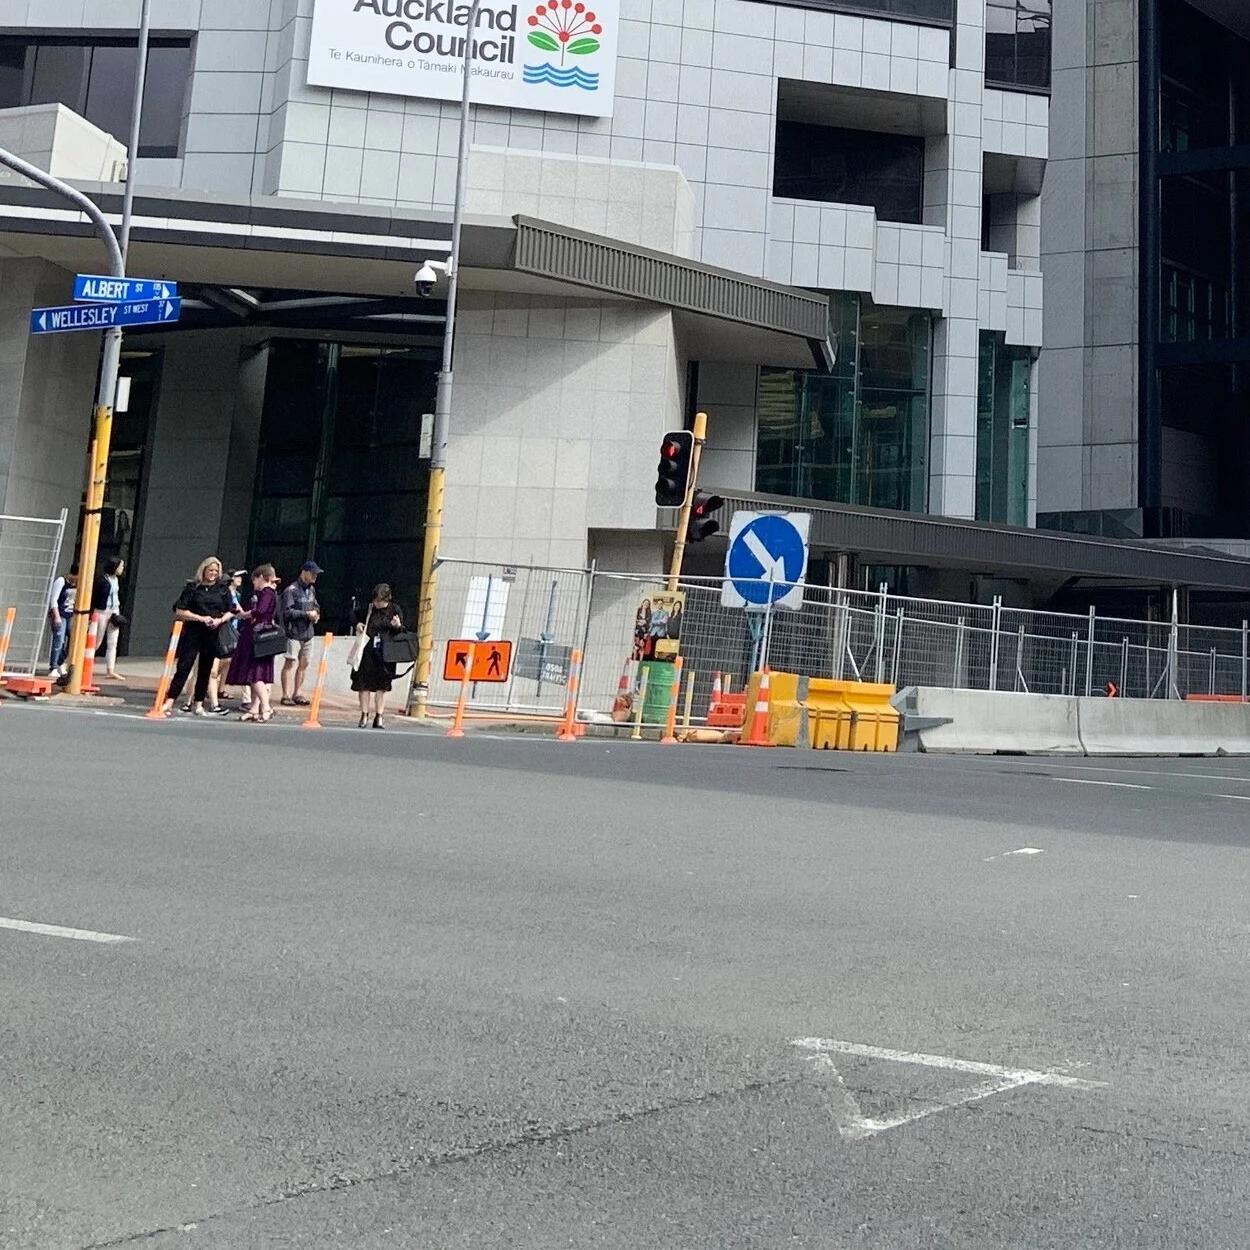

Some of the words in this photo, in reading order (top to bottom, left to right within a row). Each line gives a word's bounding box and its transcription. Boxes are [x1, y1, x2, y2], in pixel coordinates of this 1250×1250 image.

[385, 21, 515, 64] Council
[329, 48, 341, 60] Te
[345, 50, 403, 68] Kaunihera
[407, 60, 415, 69] o
[82, 279, 131, 300] ALBERT
[135, 283, 144, 293] ST
[51, 306, 118, 329] WELLESLEY
[123, 305, 132, 315] ST
[132, 303, 149, 314] WEST
